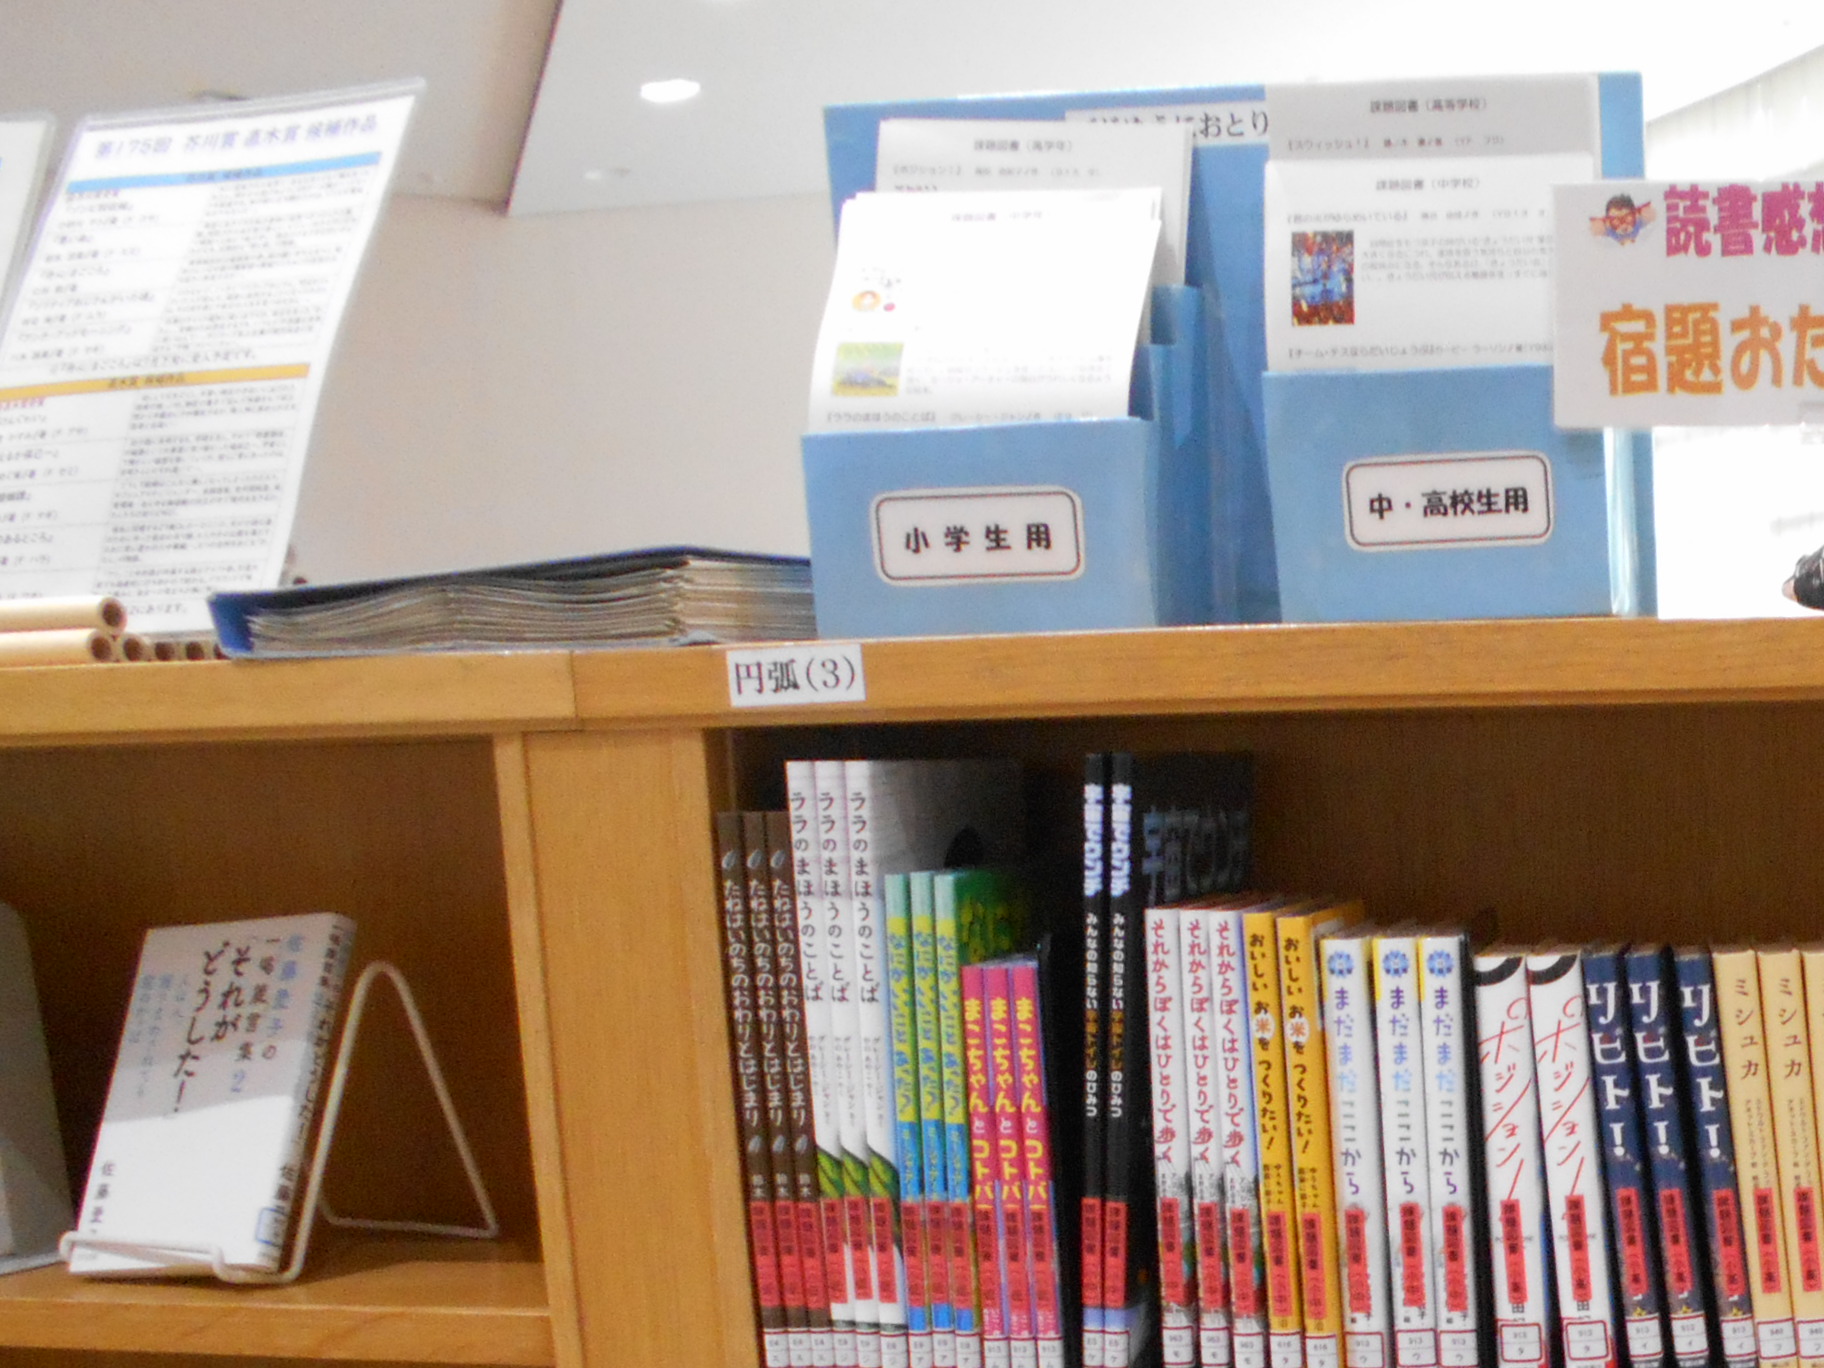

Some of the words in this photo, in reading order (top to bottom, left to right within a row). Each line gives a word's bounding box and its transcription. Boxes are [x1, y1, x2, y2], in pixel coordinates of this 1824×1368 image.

[903, 521, 1054, 555] 小学生用
[1367, 484, 1531, 522] 中・高校生用
[722, 877, 760, 1129] たねはいのちのおわりとはじまり
[747, 877, 785, 1129] たねはいのちのおわりとはじまり
[770, 877, 808, 1129] たねはいのちのおわりとはじまり
[788, 790, 825, 1003] ララのまほうのことば
[817, 790, 852, 1003] ララのまほうのことば
[847, 790, 882, 1003] ララのまほうのことば
[1150, 918, 1179, 1166] それからぼくはひとりで歩く
[1186, 918, 1215, 1166] それからぼくはひとりで歩く
[1215, 919, 1247, 1170] それからぼくはひとりで歩く
[1332, 985, 1363, 1197] まだまだここから
[1388, 985, 1417, 1196] まだまだここから
[1431, 984, 1461, 1196] まだまだここから
[1734, 977, 1761, 1081] ミシュカ
[1776, 977, 1804, 1081] ミシュカ
